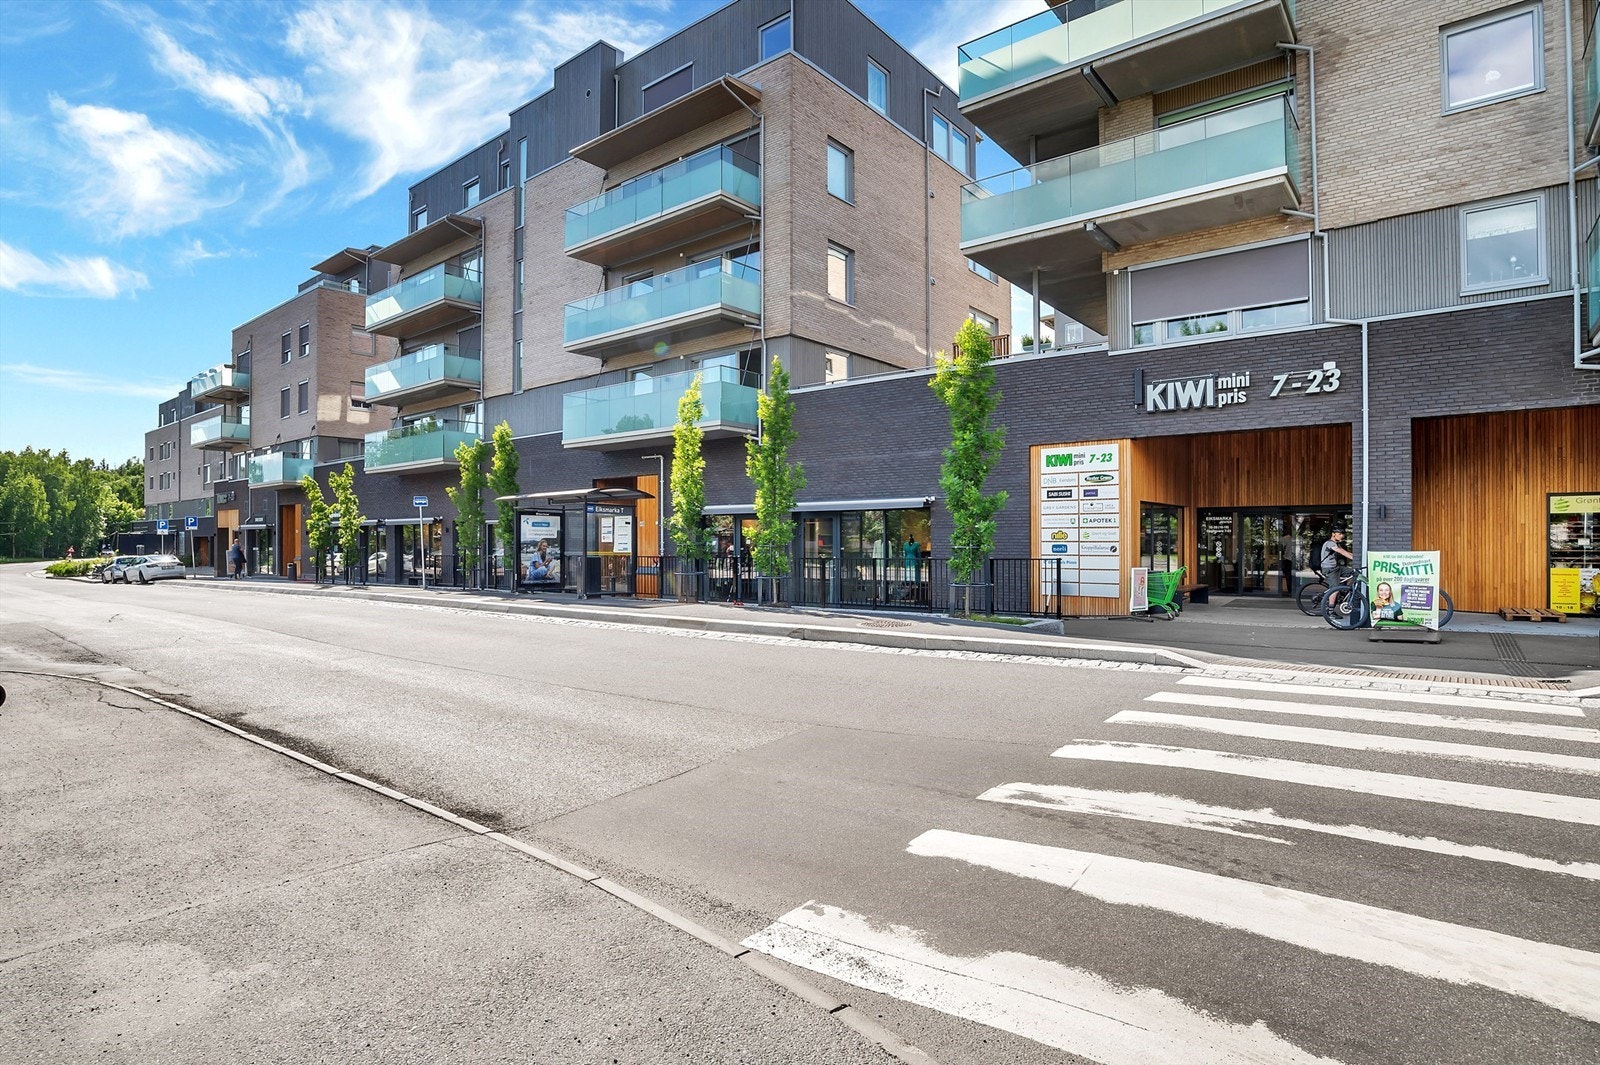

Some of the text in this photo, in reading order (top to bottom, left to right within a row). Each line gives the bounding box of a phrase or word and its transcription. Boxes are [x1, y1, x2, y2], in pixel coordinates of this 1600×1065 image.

[1146, 378, 1217, 413] KIWI
[1218, 371, 1250, 390] mini
[1218, 389, 1247, 408] pris
[1045, 453, 1073, 467] KIWI
[1043, 476, 1057, 485] DNB
[188, 517, 195, 525] P
